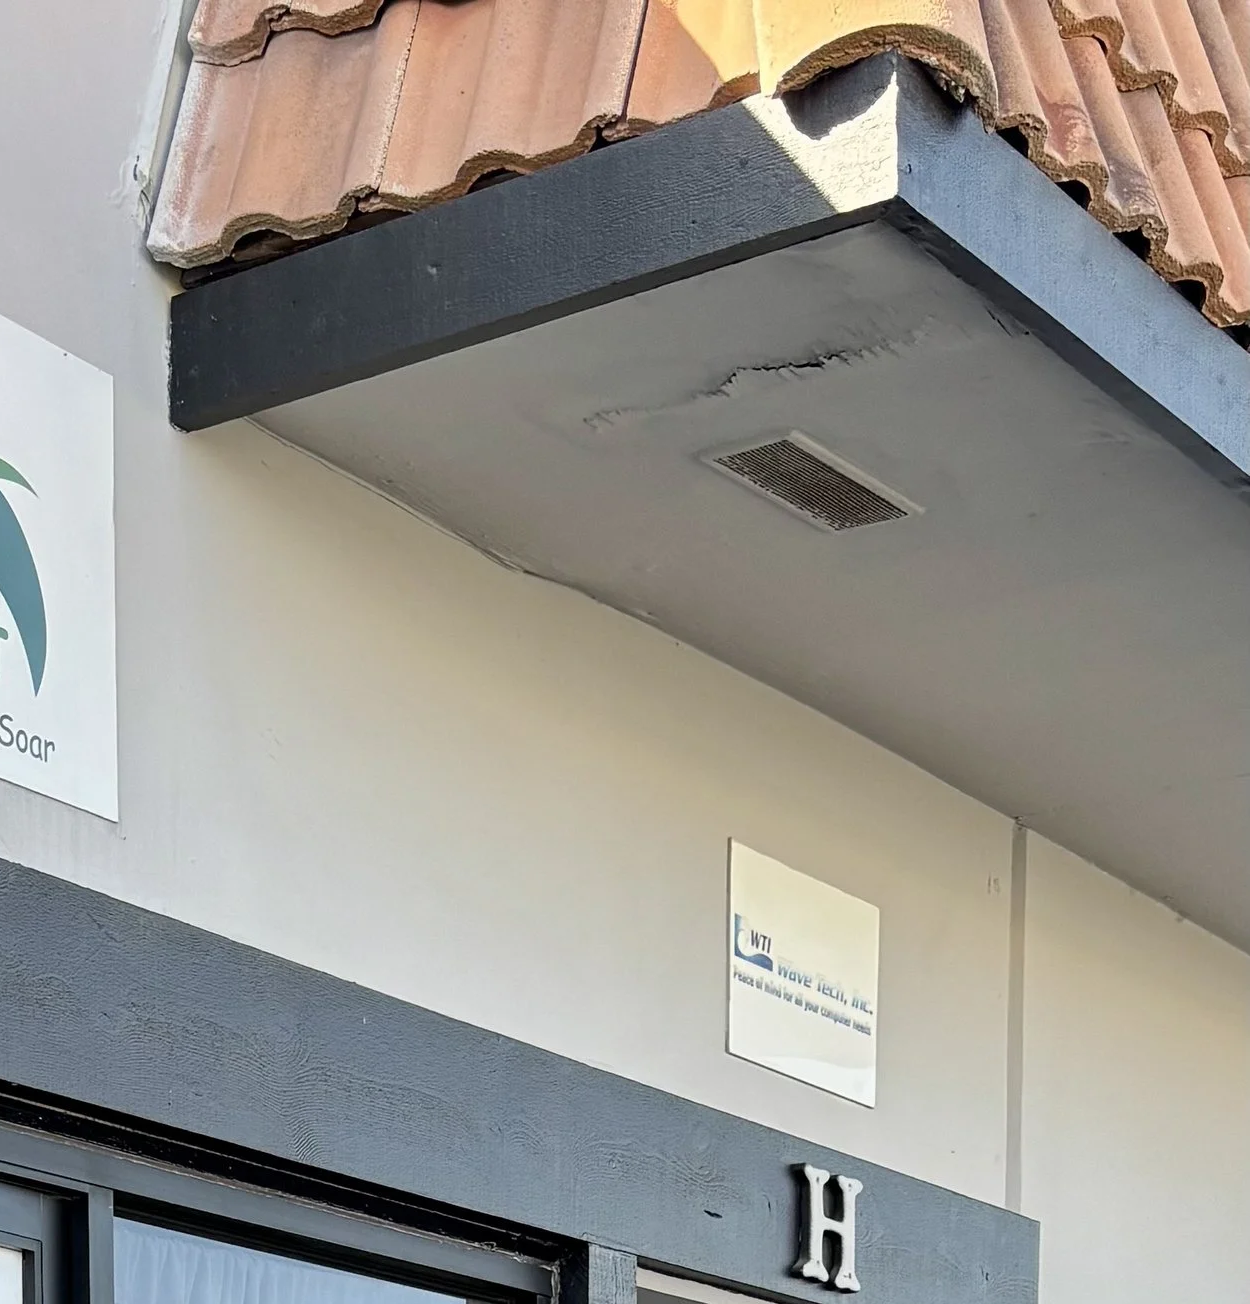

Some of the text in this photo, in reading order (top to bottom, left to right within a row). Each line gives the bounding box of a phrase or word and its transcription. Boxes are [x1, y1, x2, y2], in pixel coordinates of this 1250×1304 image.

[750, 929, 772, 954] WTI
[777, 957, 812, 989] Wave
[800, 1163, 863, 1293] H
